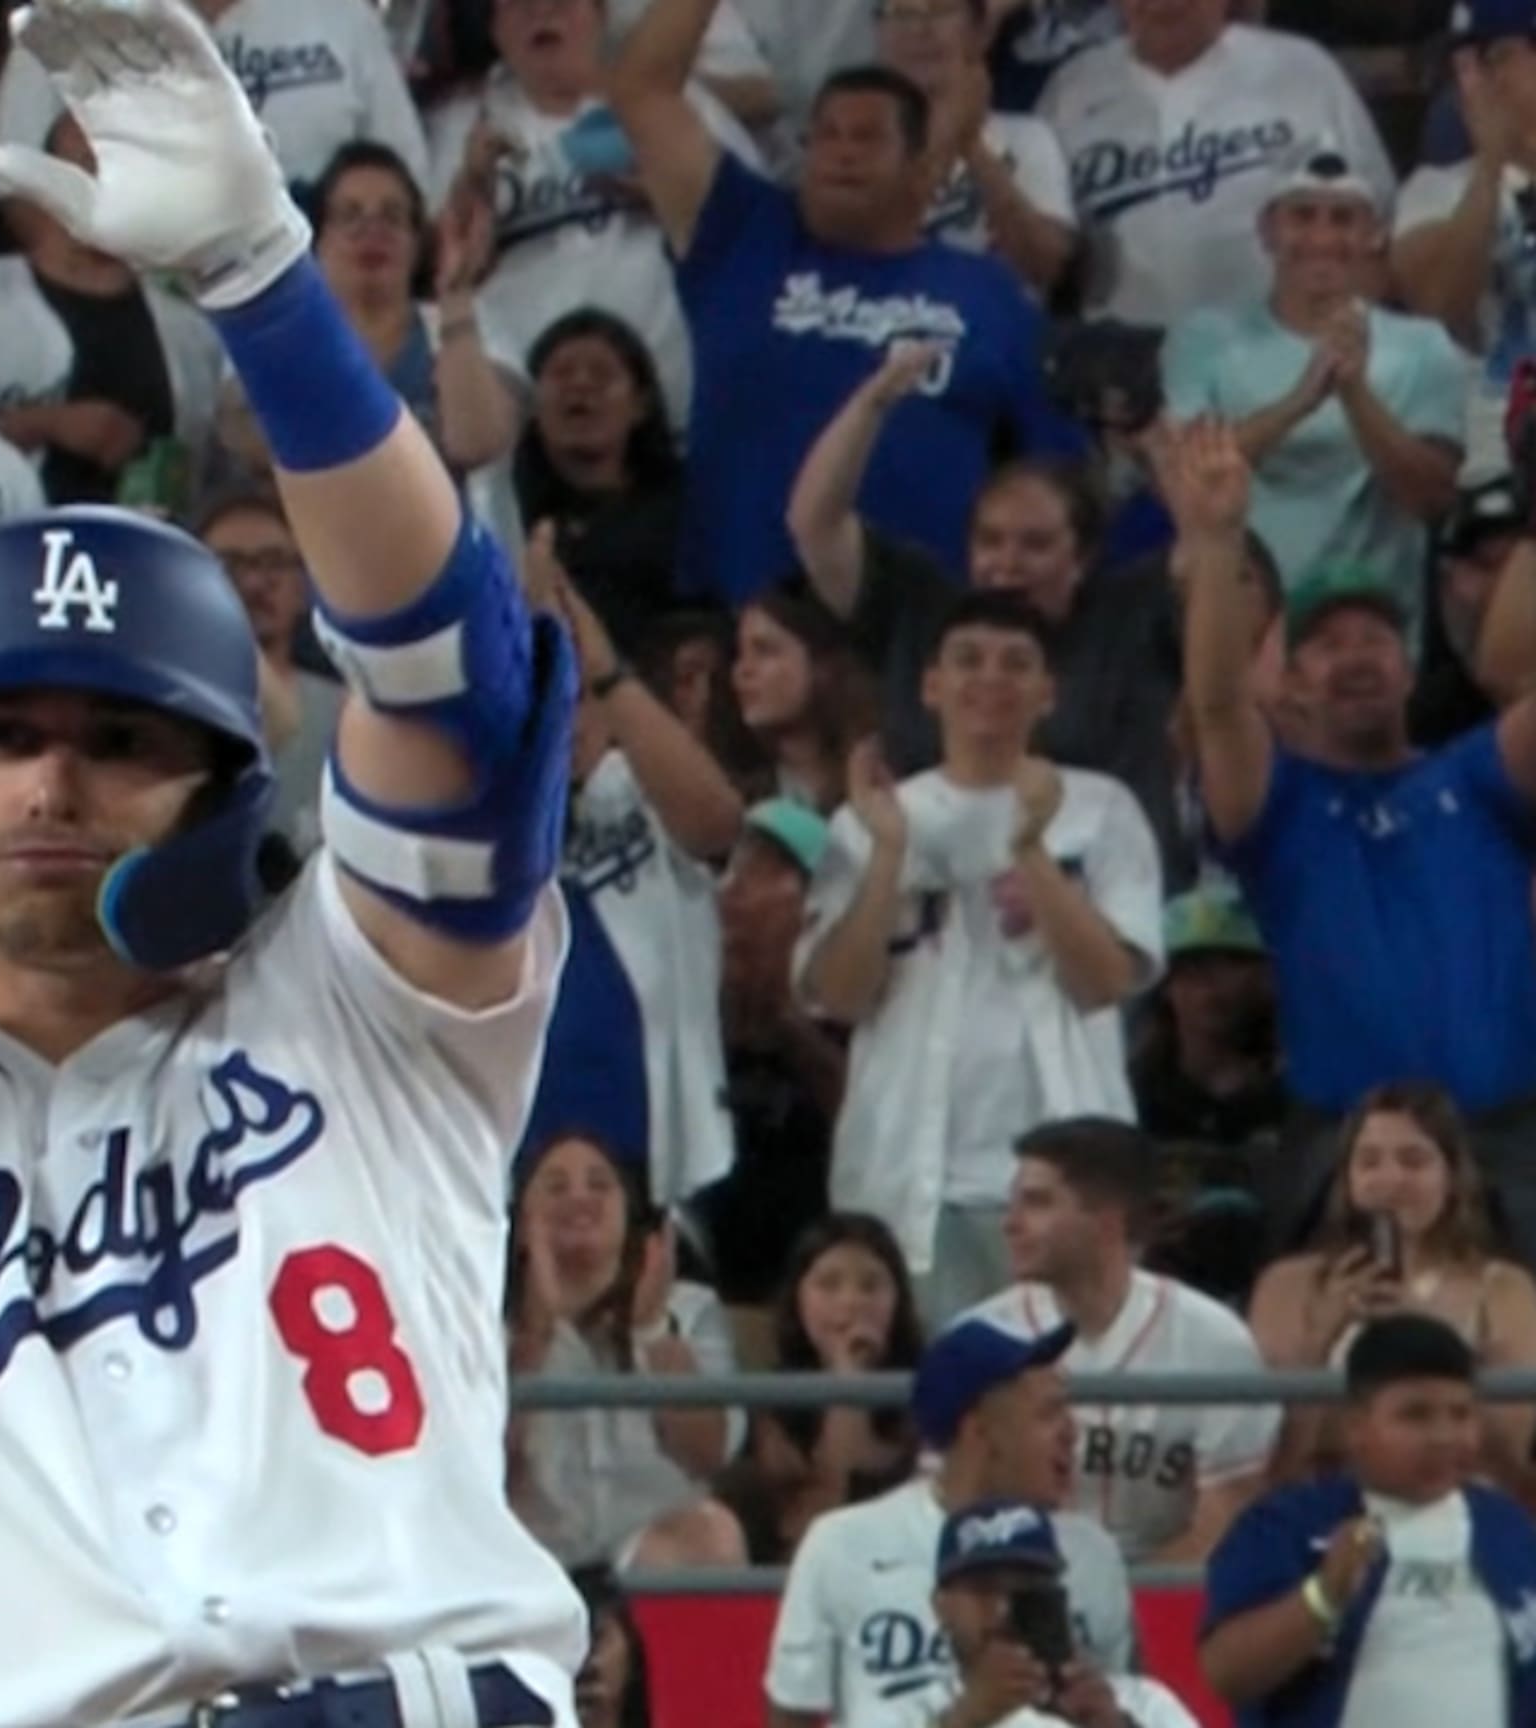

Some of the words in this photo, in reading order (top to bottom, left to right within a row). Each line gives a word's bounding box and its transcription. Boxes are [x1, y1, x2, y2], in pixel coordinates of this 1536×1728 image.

[1070, 118, 1294, 220] Dodgers
[32, 528, 119, 632] LA
[267, 1242, 426, 1459] 8
[1082, 1424, 1195, 1492] ROS
